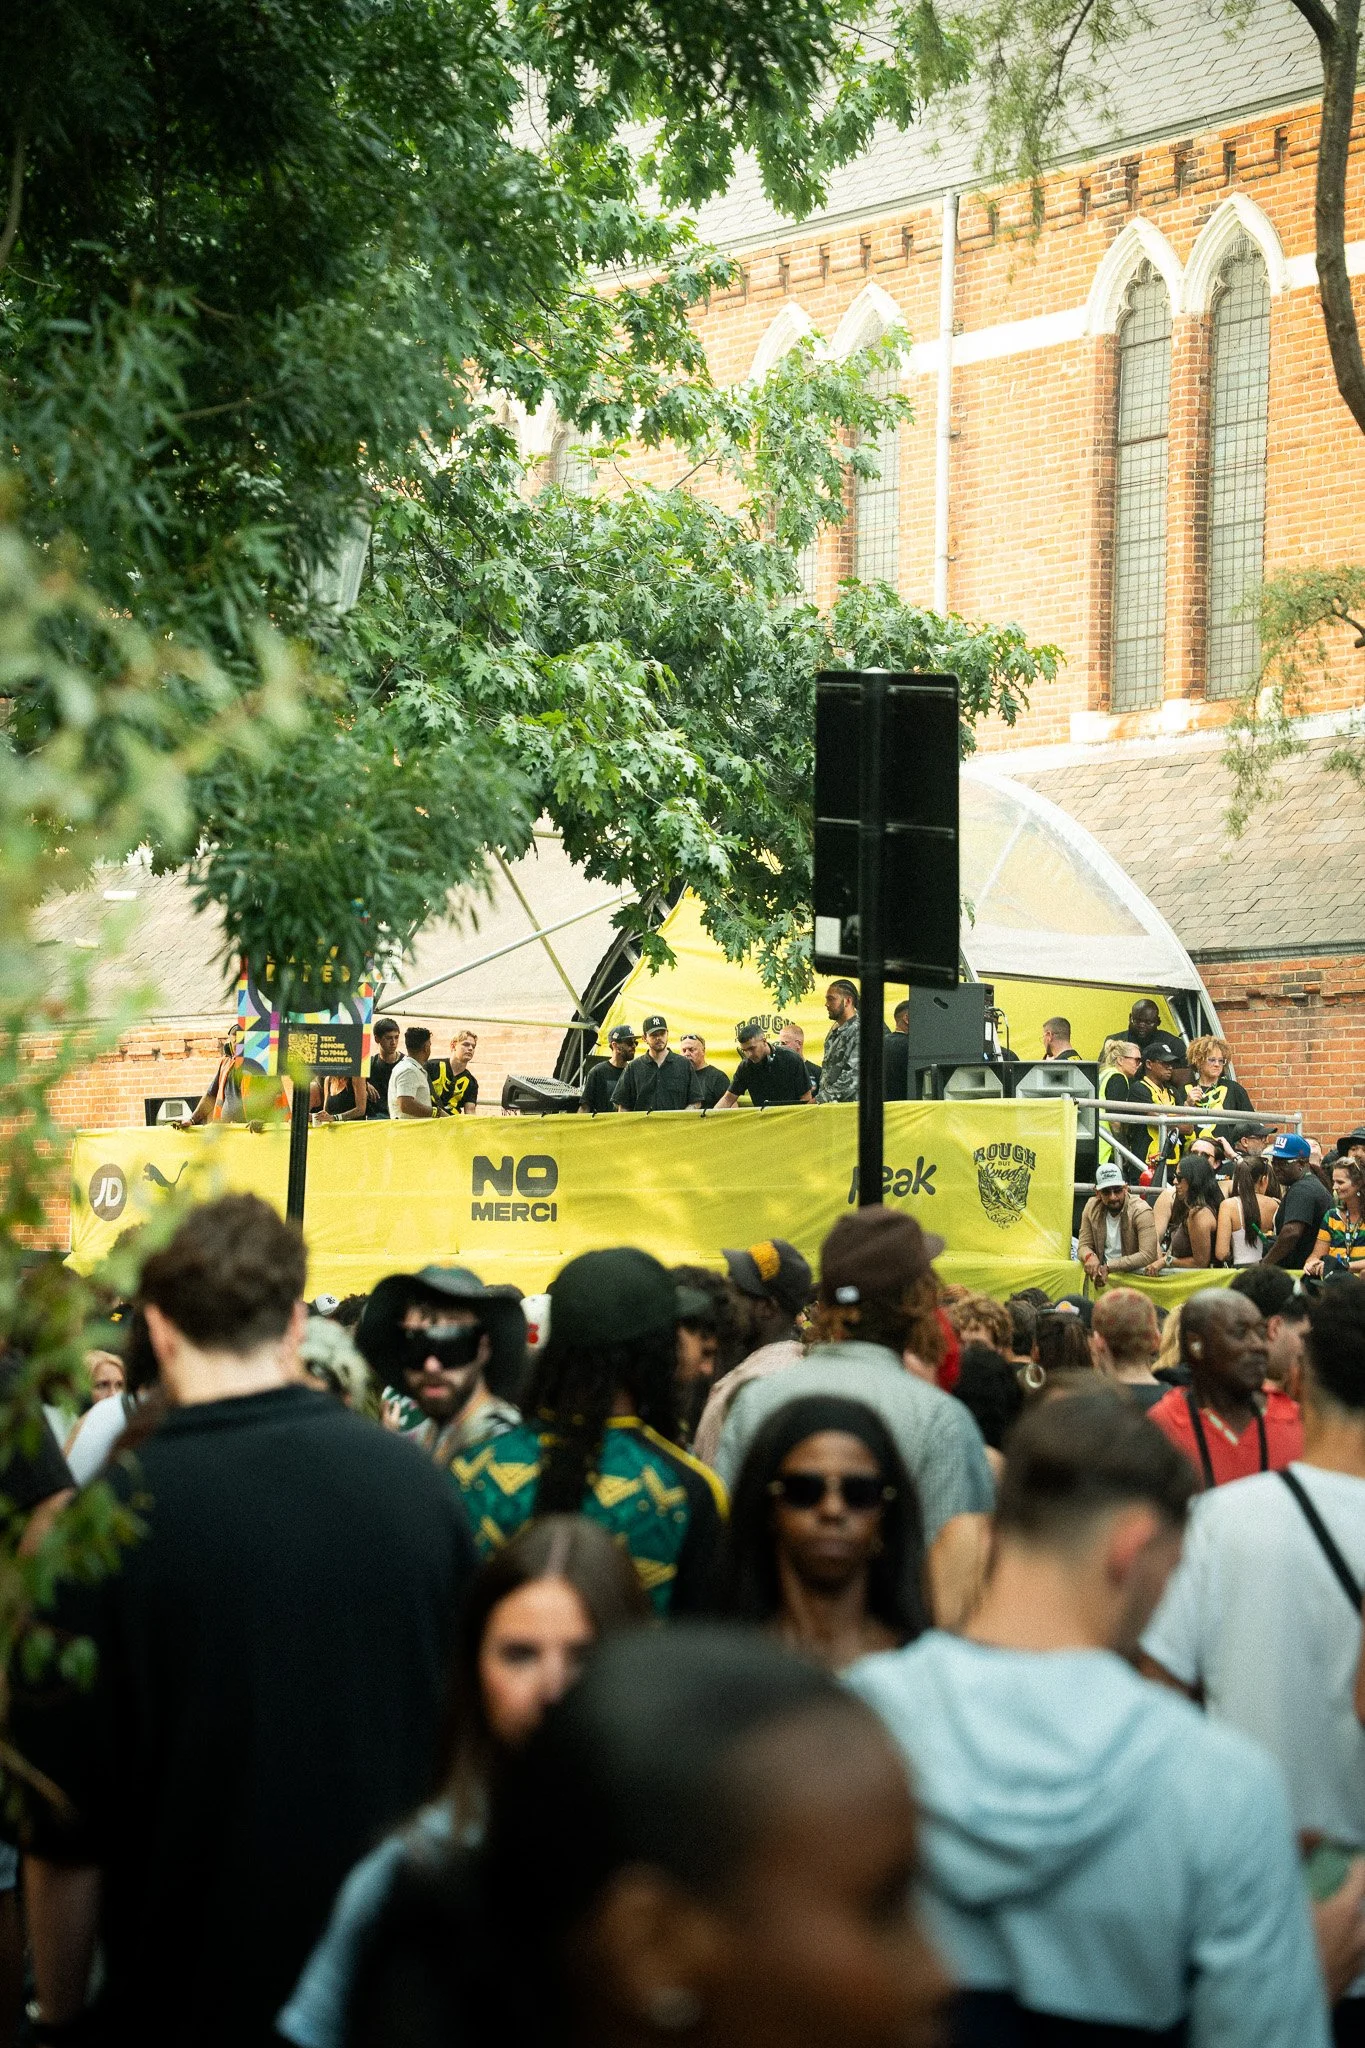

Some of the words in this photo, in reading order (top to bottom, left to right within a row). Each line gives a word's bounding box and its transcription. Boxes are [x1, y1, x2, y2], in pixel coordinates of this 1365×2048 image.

[973, 1142, 1036, 1170] ROUGH
[472, 1155, 558, 1197] NO
[985, 1162, 1024, 1182] Sweet
[93, 1177, 123, 1207] JD
[471, 1201, 557, 1222] MERCI
